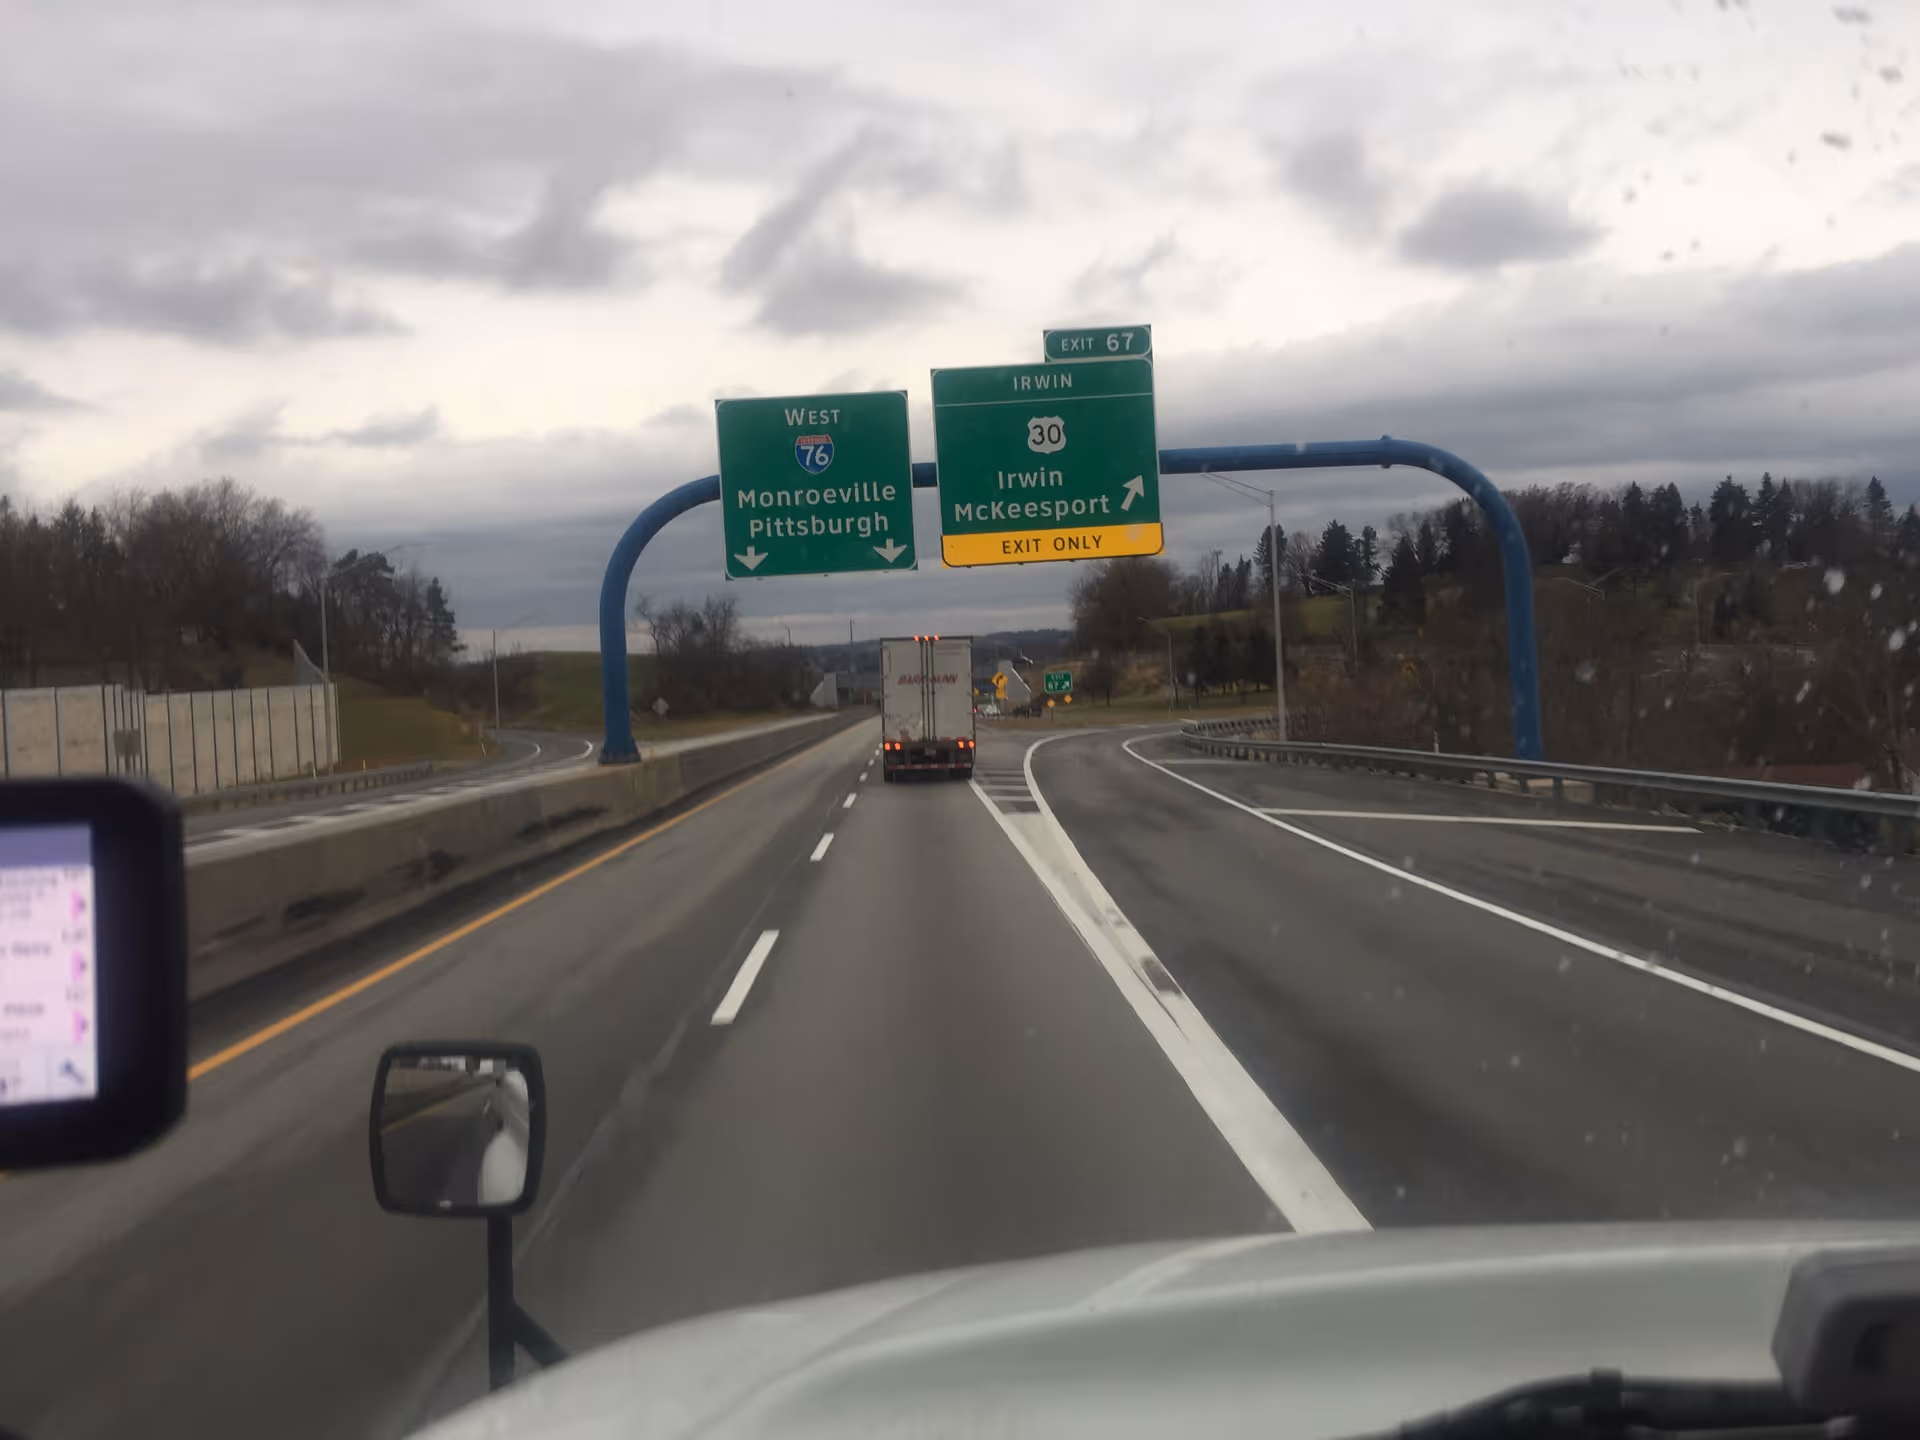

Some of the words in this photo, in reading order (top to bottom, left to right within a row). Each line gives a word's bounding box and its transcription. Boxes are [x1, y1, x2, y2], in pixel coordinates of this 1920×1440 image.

[1061, 337, 1095, 352] EXIT
[1106, 332, 1135, 352] 67
[1013, 373, 1073, 391] IRWIN
[784, 408, 841, 426] WEST
[1031, 424, 1062, 446] 30
[800, 444, 830, 466] 76
[998, 467, 1063, 490] Irwin
[738, 481, 897, 508] Monroeville
[954, 494, 1110, 522] McKeesport
[749, 511, 889, 539] Pittsburgh
[1002, 538, 1041, 554] EXIT
[1052, 535, 1103, 552] ONLY
